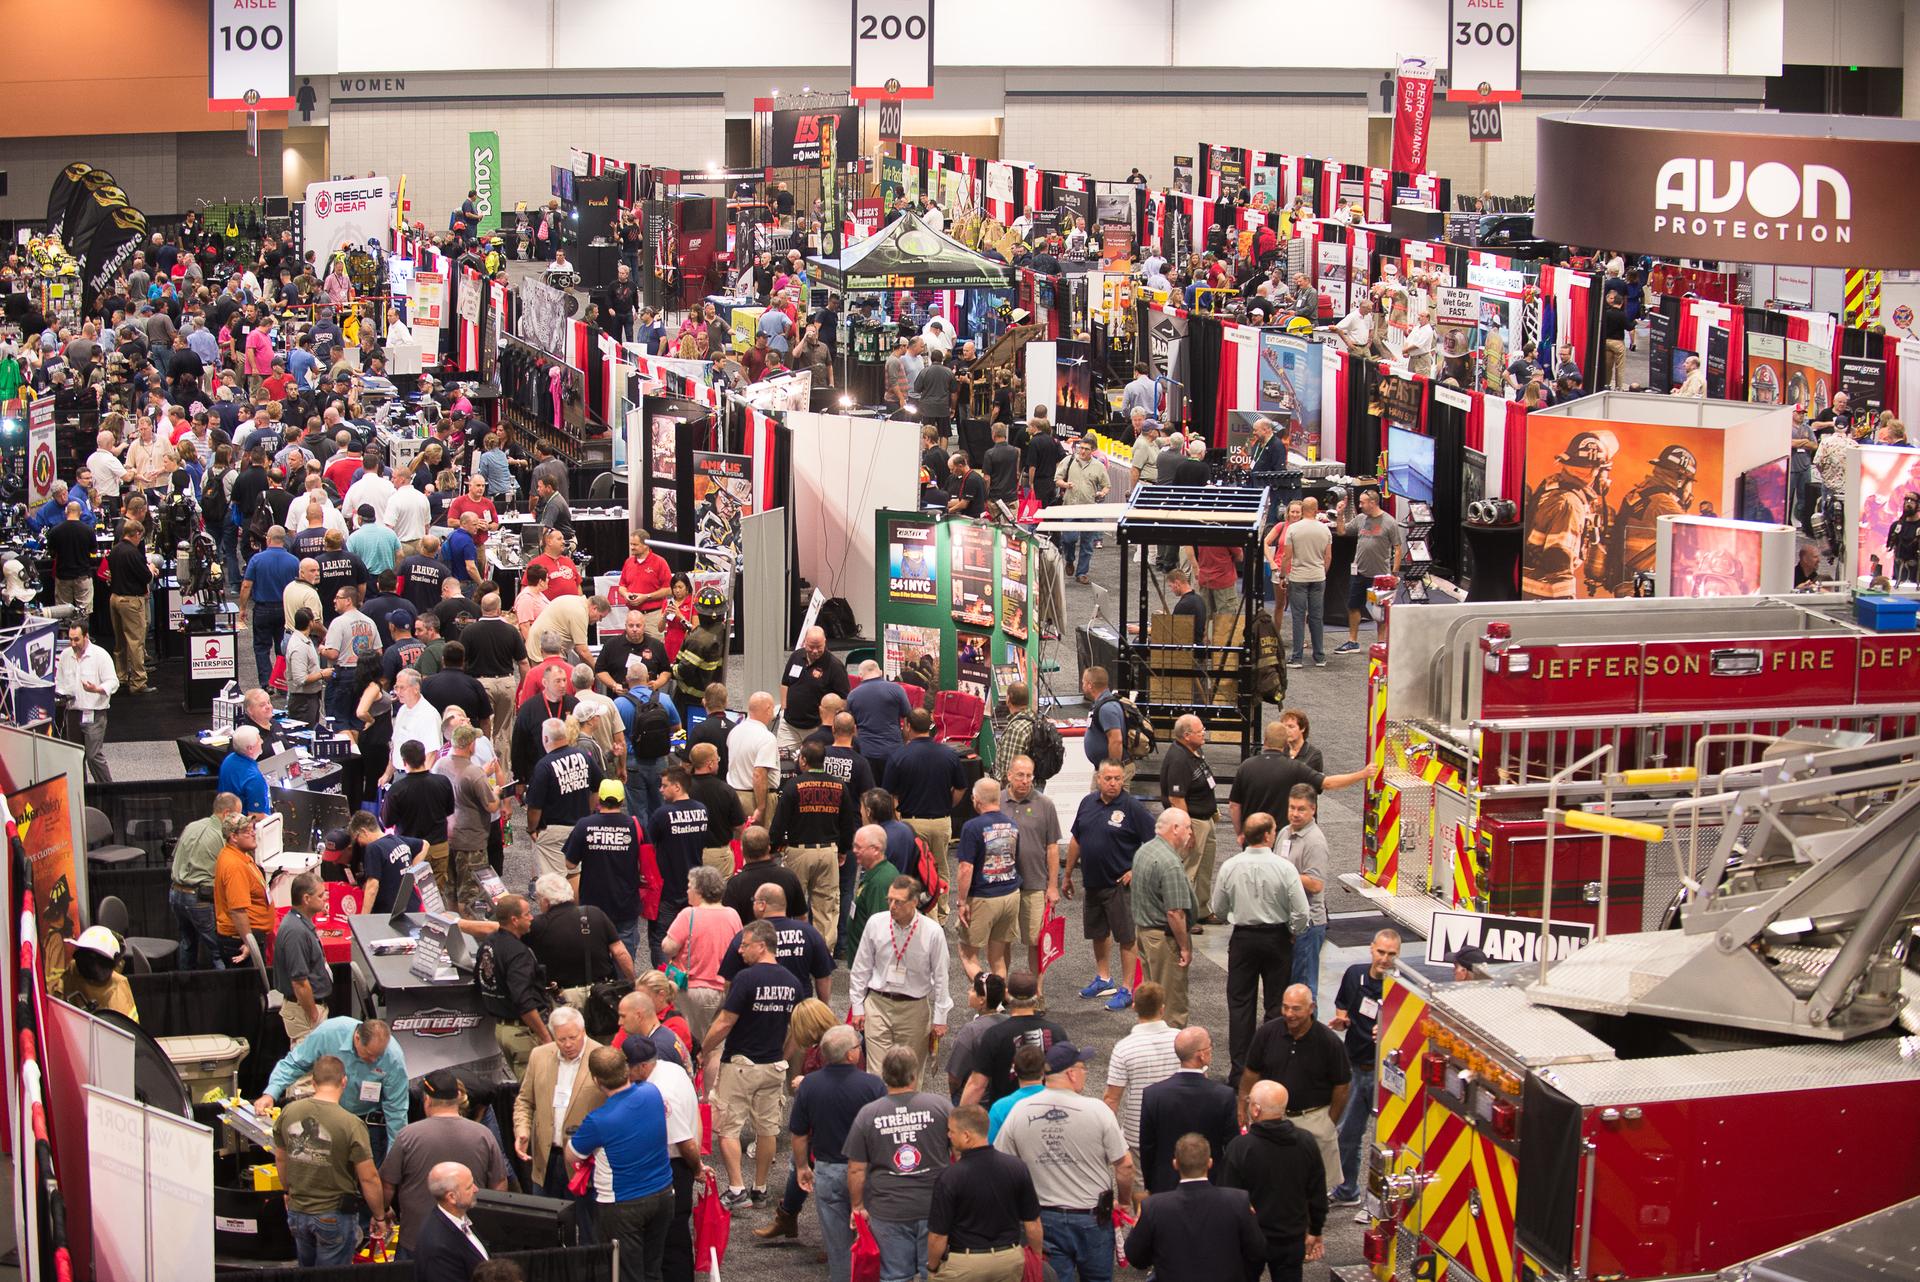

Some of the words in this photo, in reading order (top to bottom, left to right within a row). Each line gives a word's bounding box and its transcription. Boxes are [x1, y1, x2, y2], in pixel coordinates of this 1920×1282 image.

[233, 0, 277, 9] AISLE
[1467, 0, 1505, 8] AISLE
[859, 15, 926, 40] 200
[1456, 22, 1515, 46] 300
[220, 25, 283, 51] 100
[340, 78, 406, 92] WOMEN
[1404, 81, 1415, 113] GEAR
[880, 107, 900, 134] 200
[1411, 81, 1427, 165] PERFORMANCE
[1470, 109, 1500, 135] 300
[333, 187, 384, 202] RESCUE
[1655, 156, 1852, 221] AVON
[334, 200, 368, 213] GEAR
[1654, 215, 1852, 244] PROTECTION
[90, 232, 143, 293] TheFireStore
[847, 273, 915, 289] IdentiFire
[1447, 290, 1457, 298] We
[1458, 291, 1470, 300] Dry
[1443, 298, 1455, 307] Wet
[1449, 307, 1467, 316] FAST.
[1327, 336, 1338, 346] Dry
[1230, 445, 1242, 454] US
[1588, 449, 1598, 461] 11
[323, 570, 344, 578] Station
[410, 574, 431, 583] Station
[890, 579, 931, 592] 541NYC
[901, 631, 922, 643] FIRE
[399, 647, 425, 666] FIR
[193, 660, 234, 668] INTERSPIRO
[1532, 654, 1700, 681] JEFFERSON
[1772, 649, 1835, 672] FIRE
[551, 752, 589, 777] N.Y.P.D.
[823, 762, 853, 780] IRE
[558, 768, 589, 786] HARBOR
[560, 780, 590, 795] PATROL
[796, 781, 822, 790] MOUNT
[797, 788, 843, 806] FIRE
[799, 805, 840, 814] DEPARTMENT
[671, 824, 699, 835] Station
[1439, 822, 1456, 844] KEE
[593, 832, 624, 845] FIRE
[37, 843, 60, 860] CLOTHING
[1442, 914, 1581, 964] MARION
[793, 946, 804, 956] 41
[752, 1002, 784, 1012] Station
[391, 1016, 484, 1031] SOUTHEAST
[895, 1106, 908, 1114] FOR
[873, 1111, 935, 1129] STRENGTH,
[880, 1124, 923, 1136] INDEPENDENCE
[892, 1131, 917, 1145] LIFE
